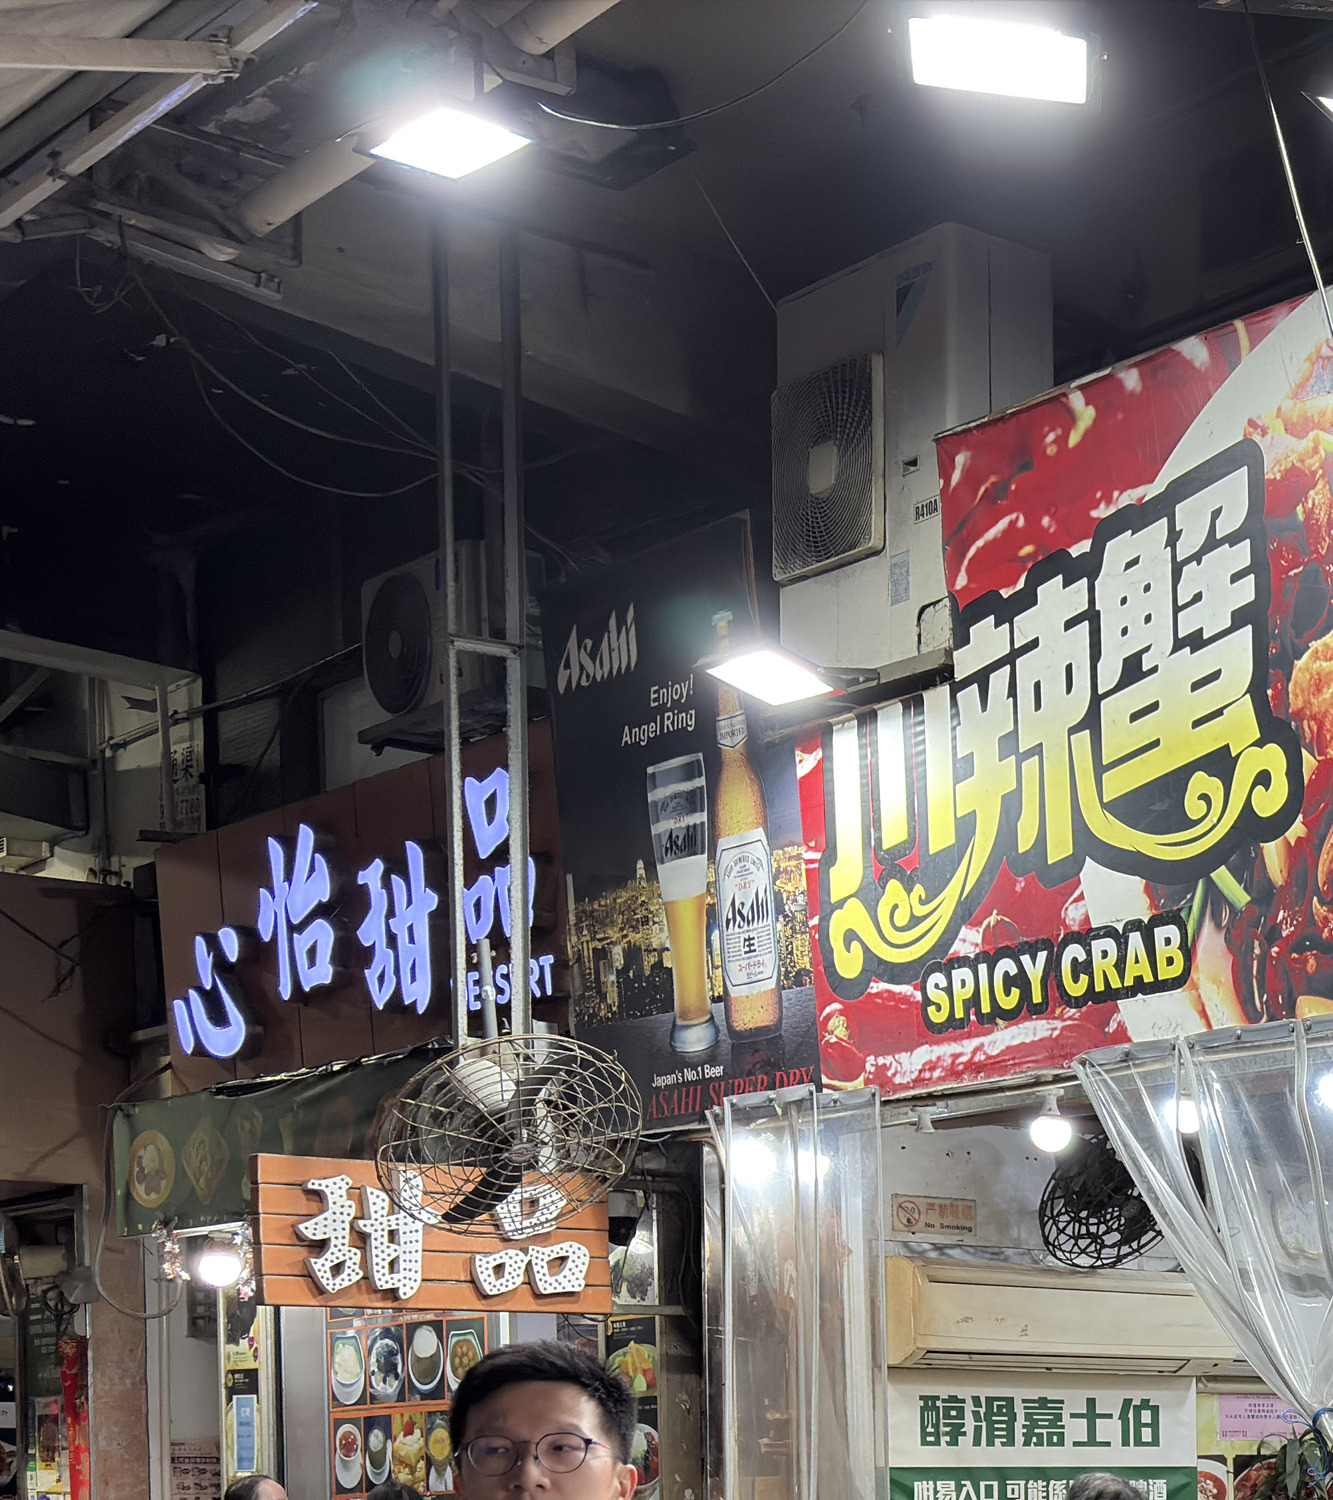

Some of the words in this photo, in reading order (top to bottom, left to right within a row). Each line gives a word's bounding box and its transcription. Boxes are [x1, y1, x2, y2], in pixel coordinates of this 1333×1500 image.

[915, 498, 938, 521] R410A
[557, 602, 638, 695] Asahi
[650, 674, 694, 707] Enjoy!
[621, 716, 660, 747] Angel
[663, 709, 696, 734] Ring
[828, 466, 1288, 980] 川辣蟹
[664, 825, 697, 858] Asahi
[173, 767, 536, 1058] 心怡甜品
[725, 883, 770, 932] Asahi
[742, 934, 757, 955] 生
[926, 949, 1048, 1024] SPICY
[1061, 923, 1185, 996] CRAB
[651, 1068, 683, 1089] Japan's
[684, 1067, 702, 1082] No.1
[704, 1064, 724, 1079] Beer
[647, 1086, 702, 1121] ASAHI
[295, 1171, 590, 1299] 甜品
[940, 1222, 973, 1233] Smoking
[919, 1394, 1160, 1447] 醇滑嘉士伯
